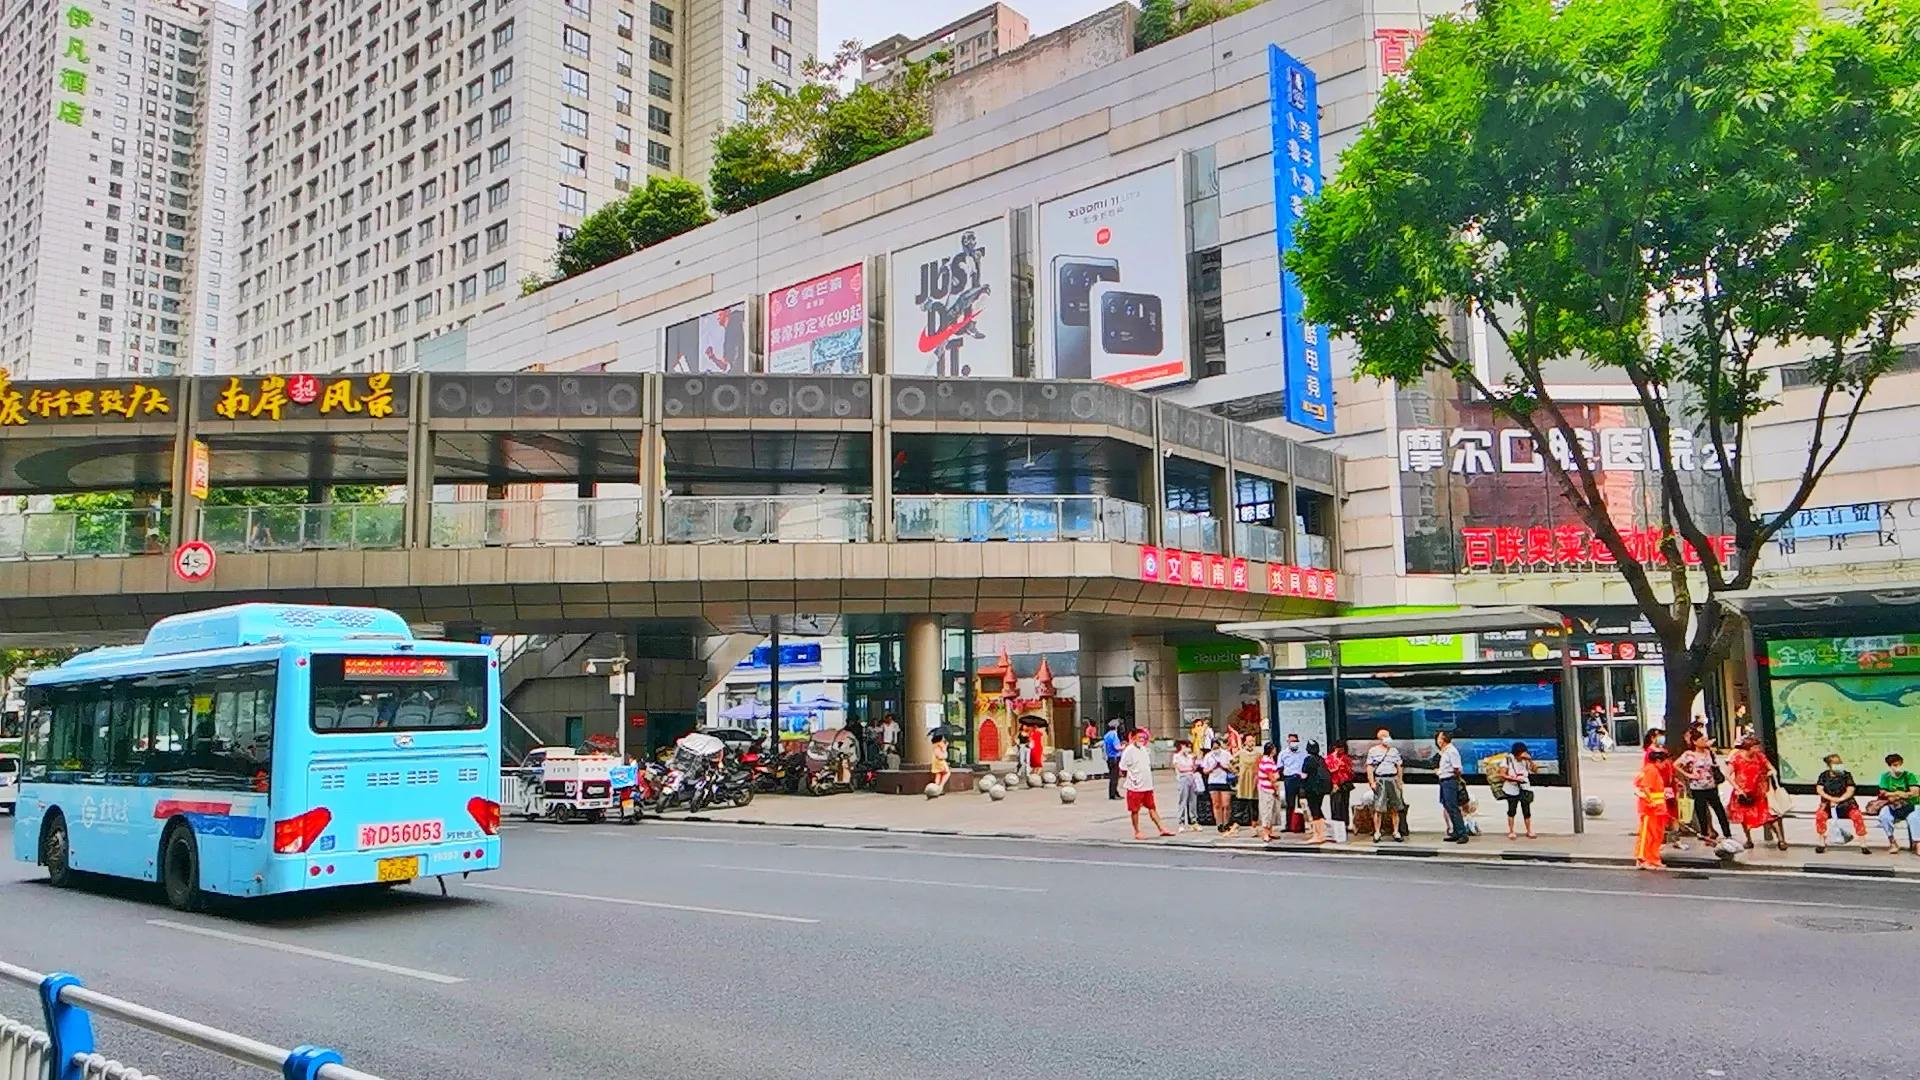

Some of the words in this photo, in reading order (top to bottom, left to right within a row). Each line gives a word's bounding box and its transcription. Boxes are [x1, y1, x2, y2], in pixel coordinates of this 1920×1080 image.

[58, 6, 94, 127] 伊凡酒店
[915, 247, 986, 305] JUST
[216, 372, 393, 421] 南岸起风景
[362, 822, 442, 847] 渝D56053
